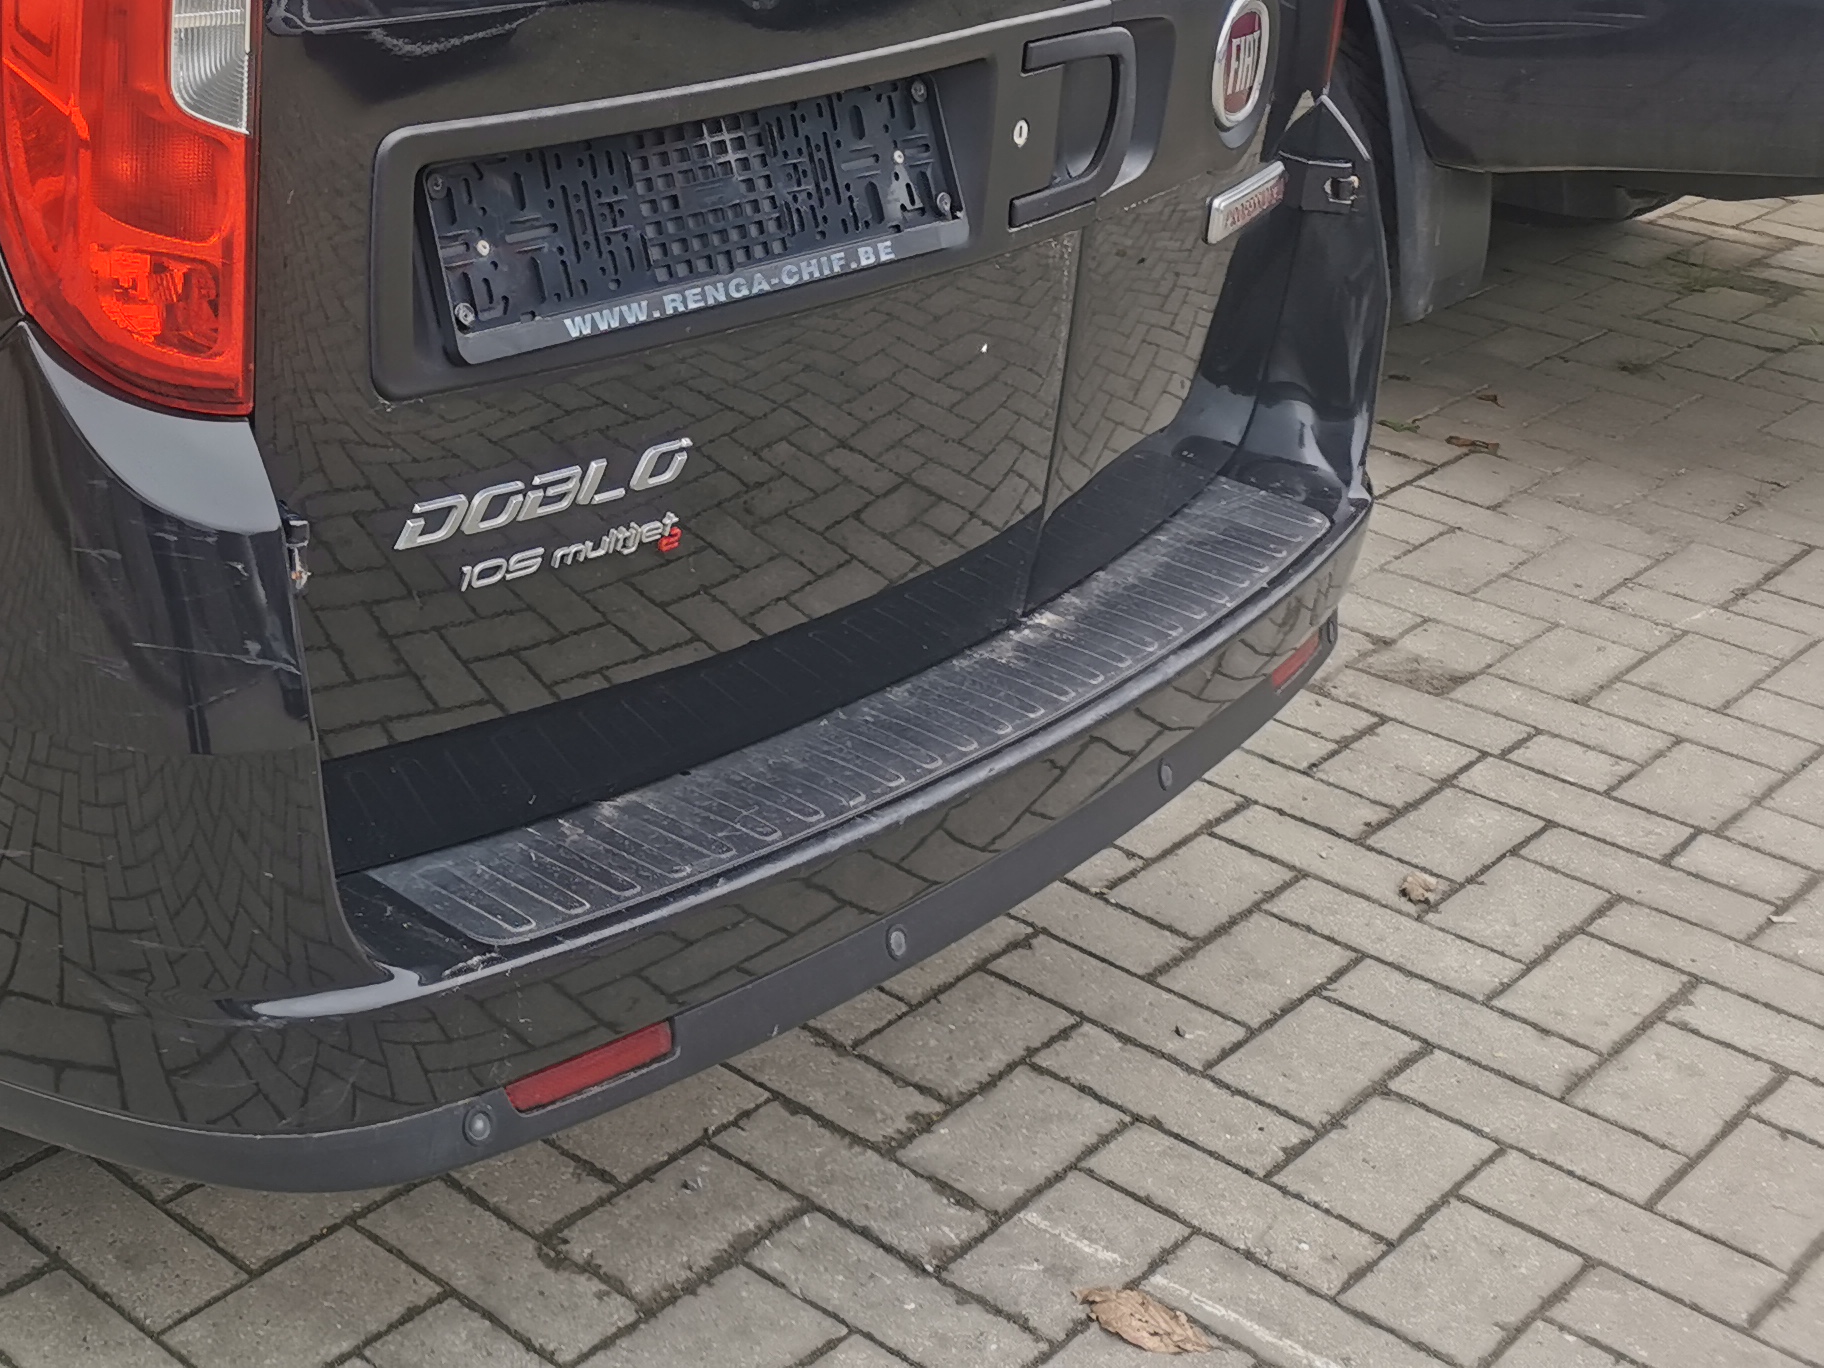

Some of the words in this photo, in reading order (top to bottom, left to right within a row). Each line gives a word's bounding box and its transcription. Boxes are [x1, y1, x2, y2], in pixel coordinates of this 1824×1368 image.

[1226, 30, 1261, 95] FIAT
[562, 240, 897, 338] WWW.RENGA-CHIF.BE
[459, 546, 545, 592] 105
